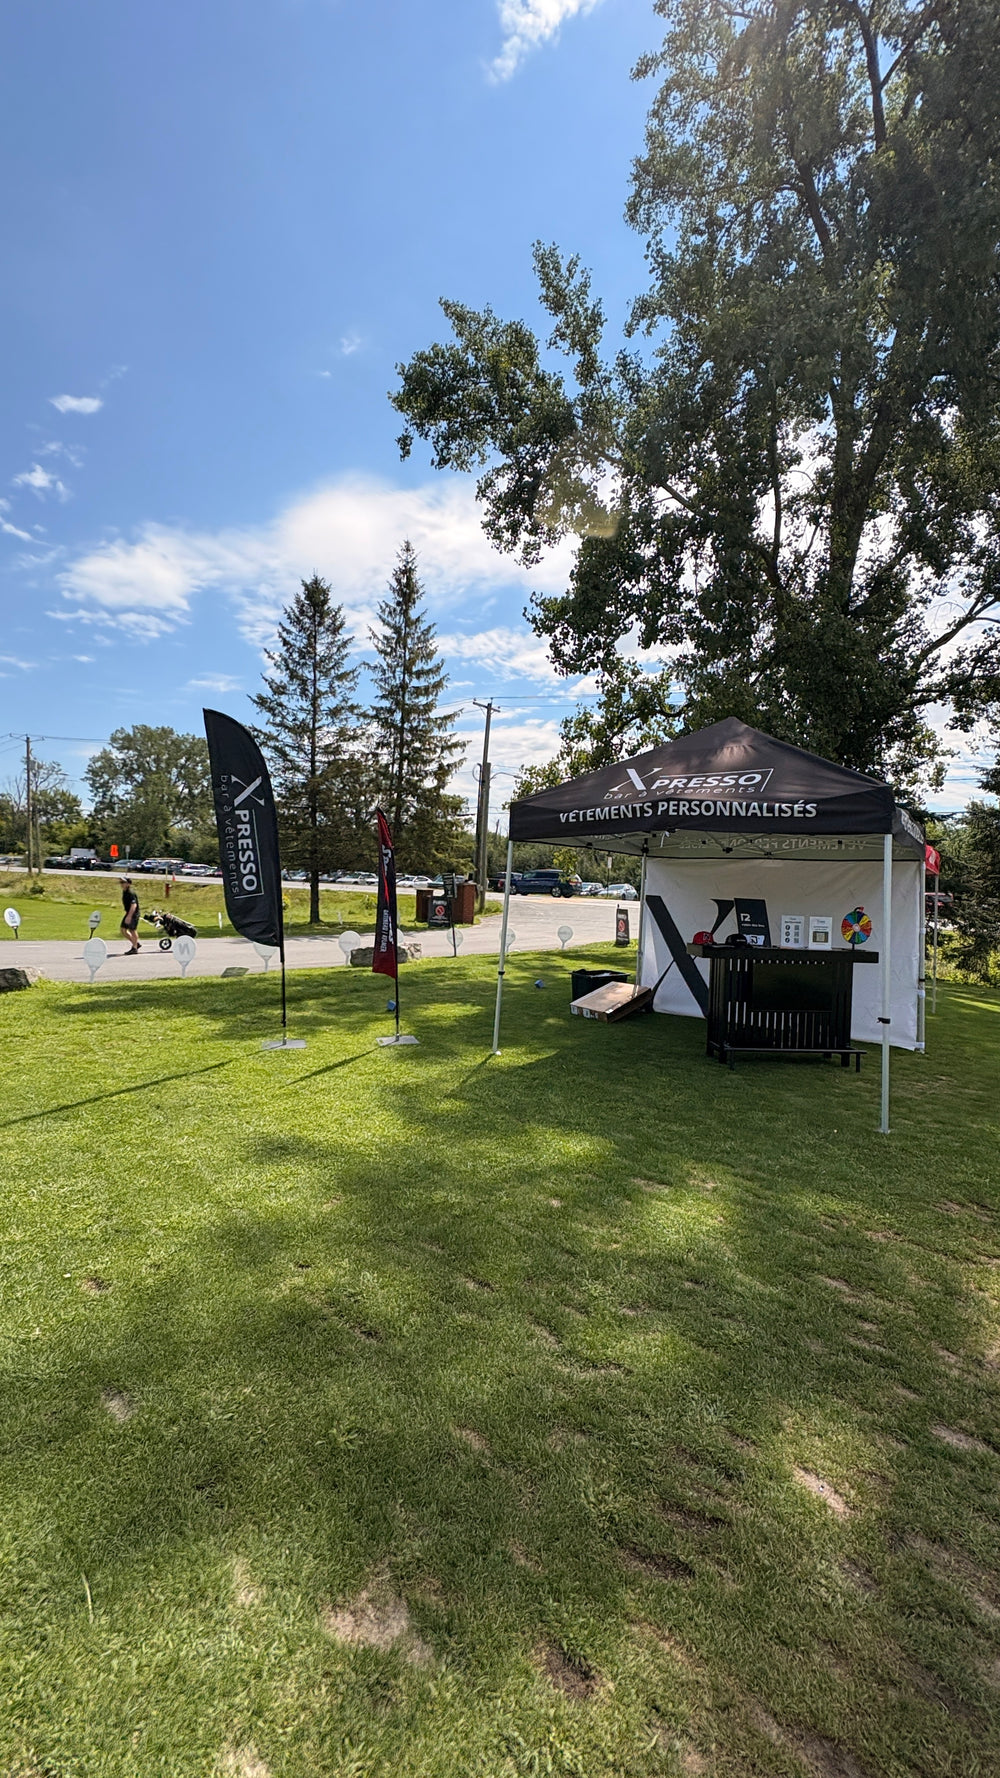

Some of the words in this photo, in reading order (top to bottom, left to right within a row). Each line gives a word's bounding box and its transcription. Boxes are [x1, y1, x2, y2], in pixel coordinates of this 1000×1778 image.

[603, 792, 633, 800] bar
[559, 802, 653, 823] VÊTEMENTS
[657, 799, 818, 818] PERSONNALISÉS
[220, 775, 230, 799] bar
[225, 818, 239, 894] vêtements
